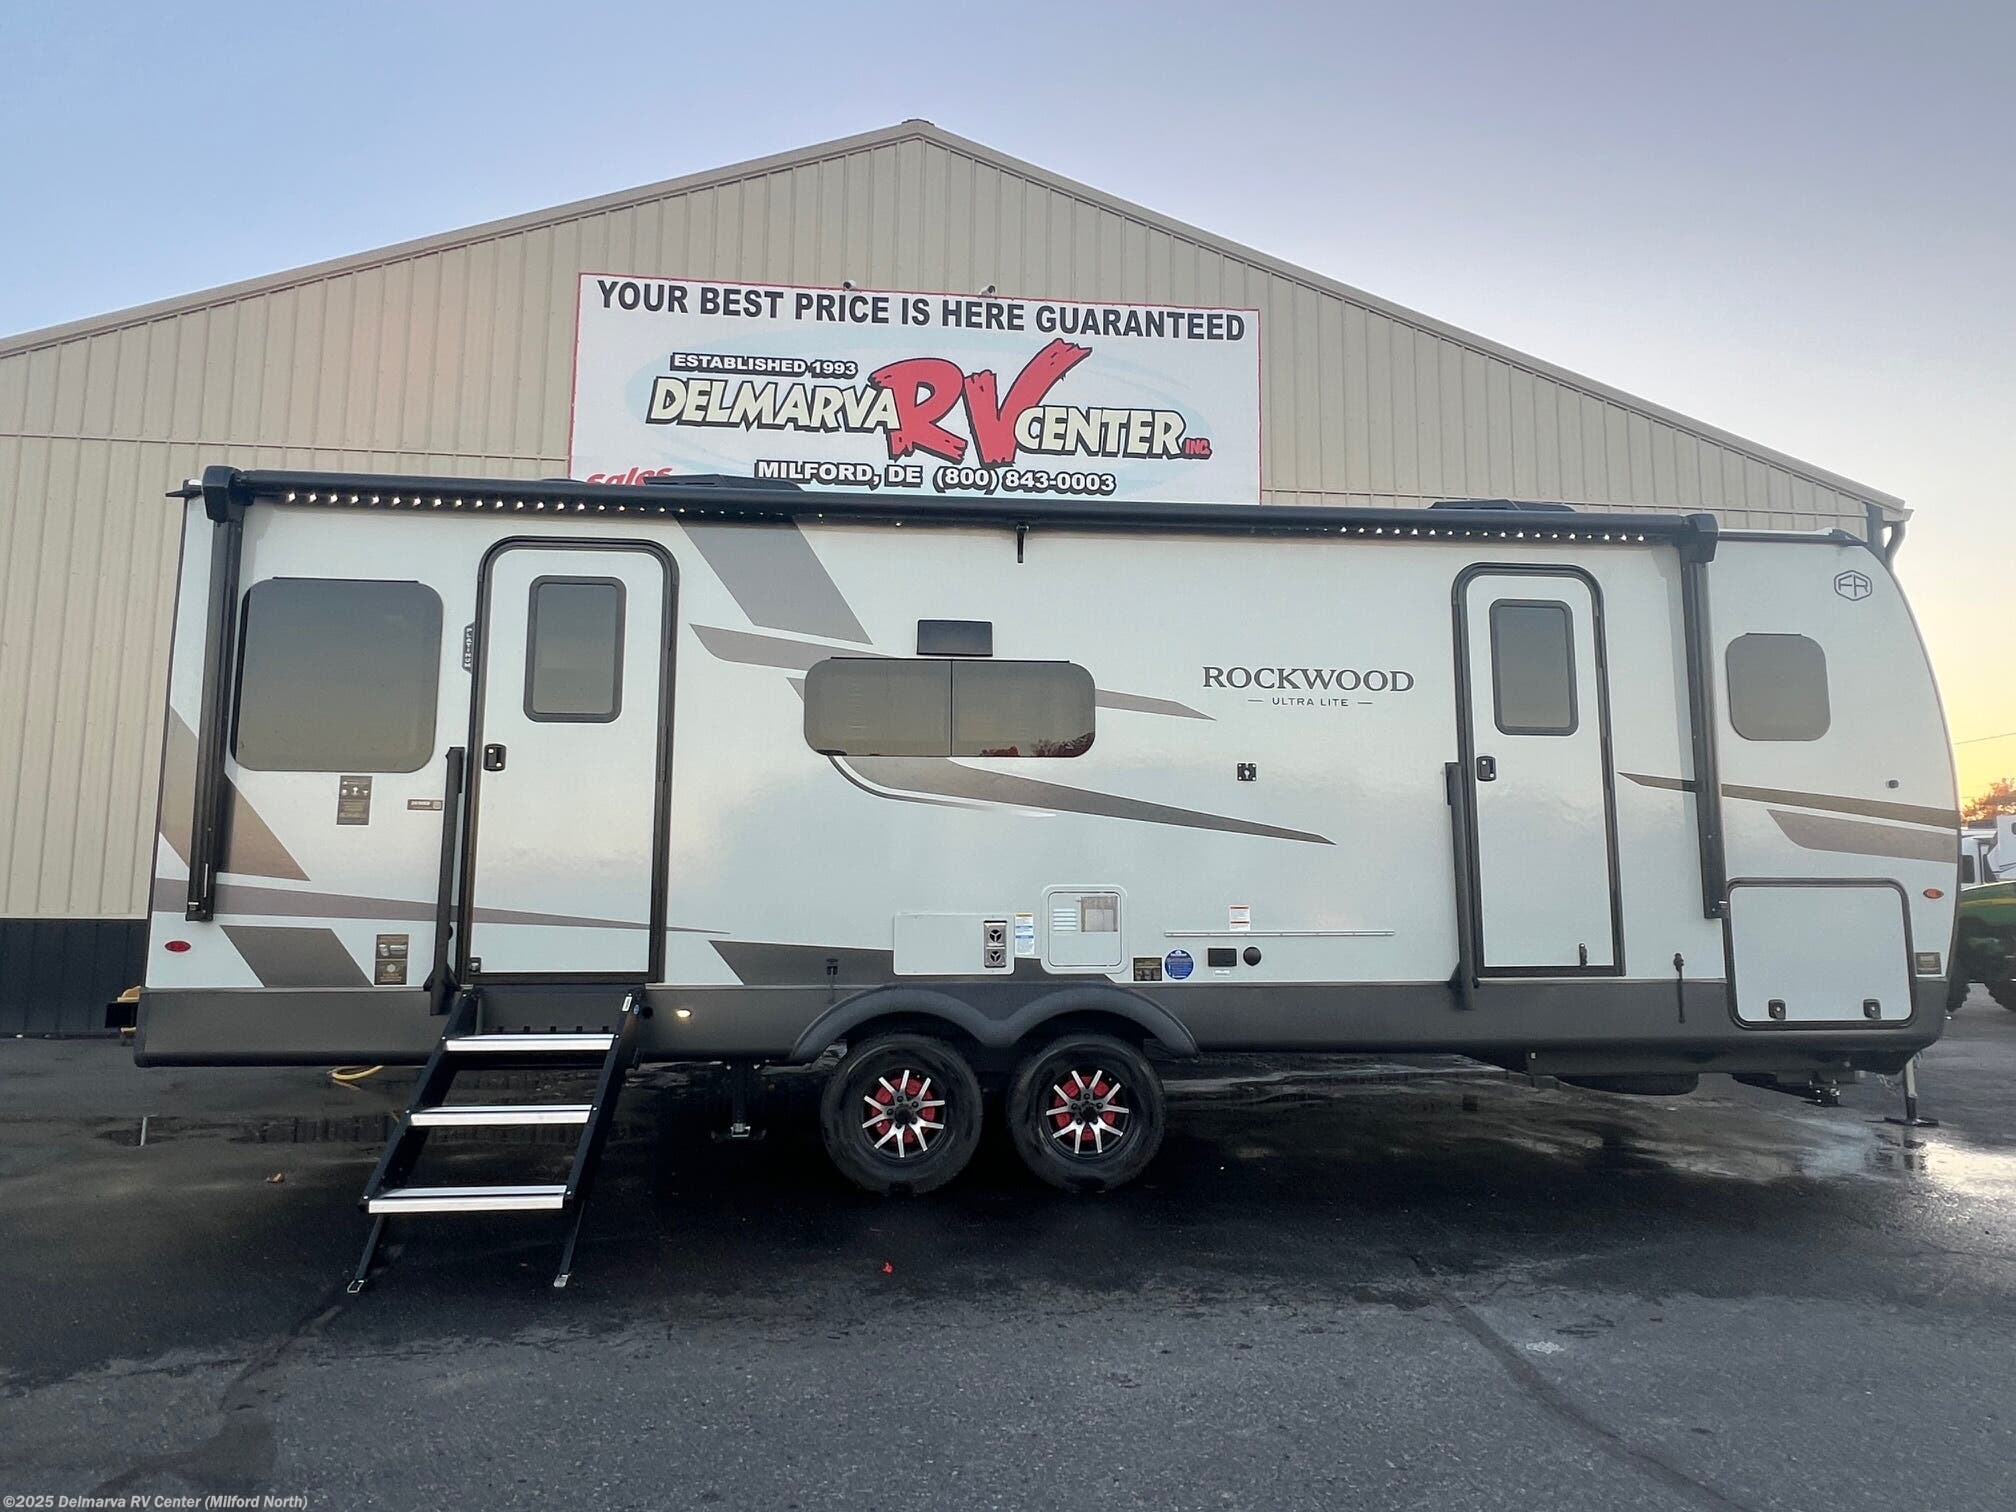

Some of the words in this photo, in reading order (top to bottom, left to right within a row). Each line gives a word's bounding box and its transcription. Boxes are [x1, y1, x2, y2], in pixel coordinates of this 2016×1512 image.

[597, 280, 688, 313] YOUR
[700, 287, 783, 319] BEST
[795, 293, 889, 324] PRICE
[901, 298, 930, 325] IS
[942, 300, 1025, 331] HERE
[1036, 305, 1245, 341] GUARANTEED
[673, 353, 807, 376] ESTABLISHED
[811, 359, 857, 376] 1993
[646, 376, 901, 432] DELMARVA
[868, 338, 1092, 468] RV
[1014, 405, 1186, 459] CENTER
[1184, 437, 1212, 459] INC.
[757, 460, 881, 488] MILFORD,
[886, 465, 922, 486] DE
[933, 466, 998, 493] (800)
[1004, 468, 1117, 495] 843-0003
[1203, 667, 1414, 691] ROCKWOOD
[1272, 697, 1315, 707] ULTRA
[1320, 698, 1350, 707] LITE
